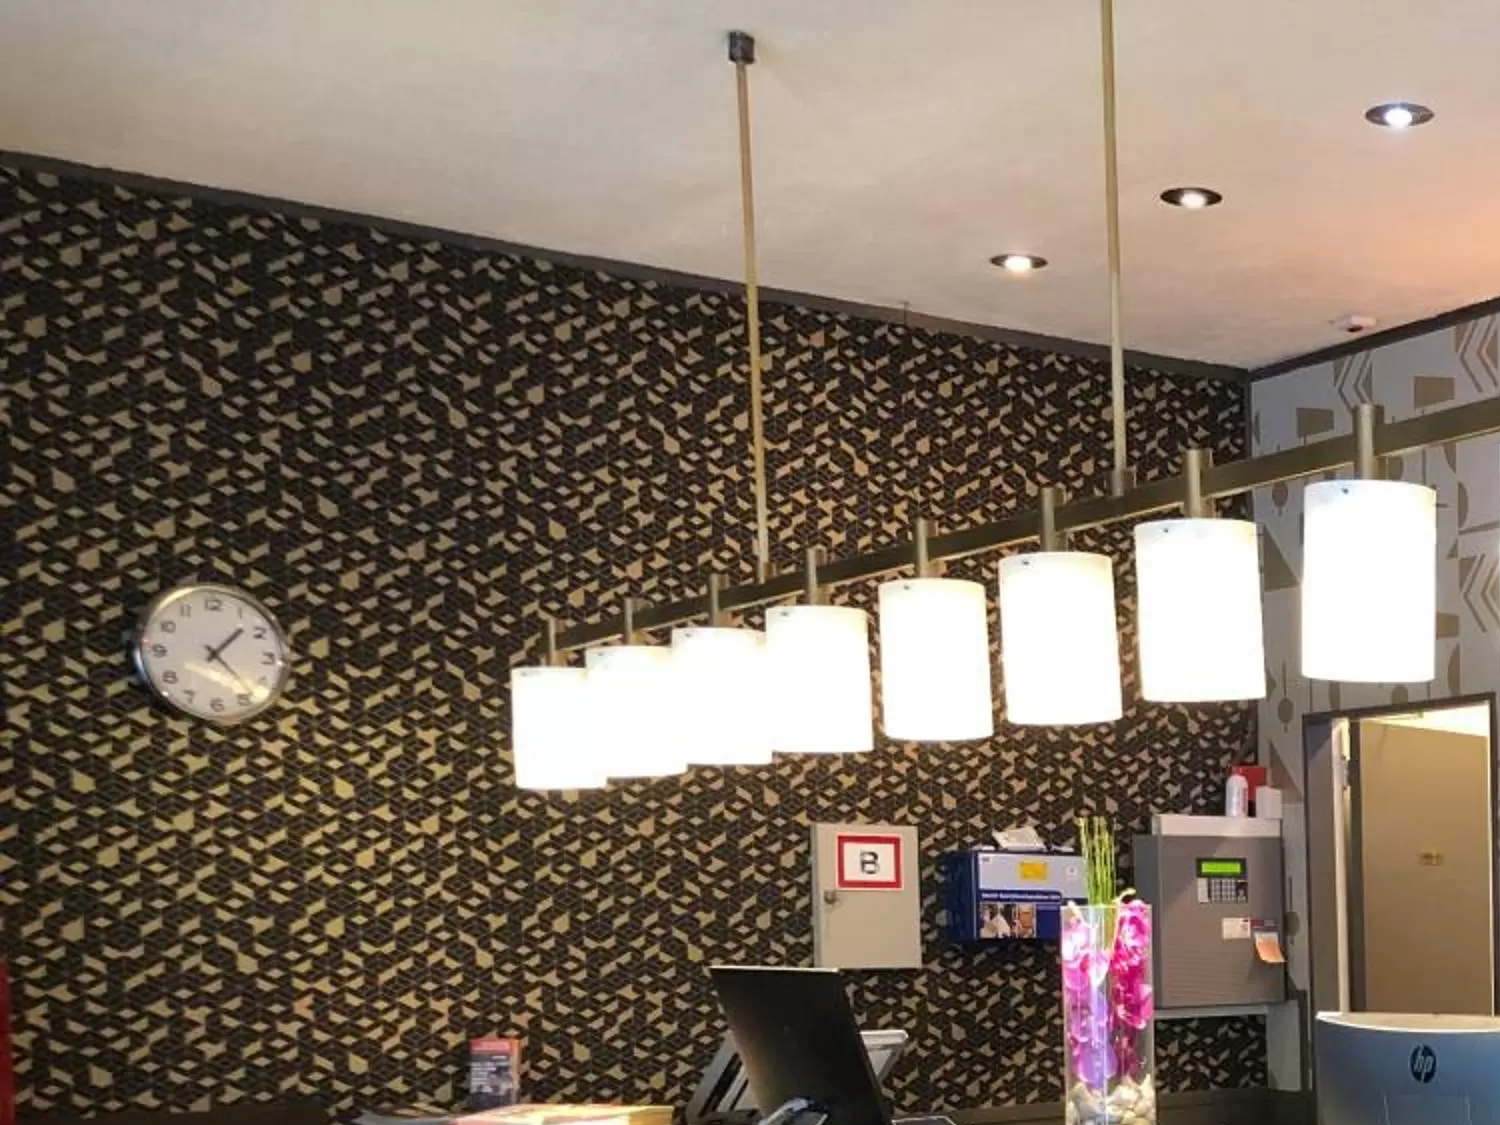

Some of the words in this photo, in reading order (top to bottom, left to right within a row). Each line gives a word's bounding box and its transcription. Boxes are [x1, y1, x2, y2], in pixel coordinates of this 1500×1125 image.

[183, 690, 196, 705] 7
[860, 851, 880, 874] B
[1411, 1043, 1437, 1084] hp
